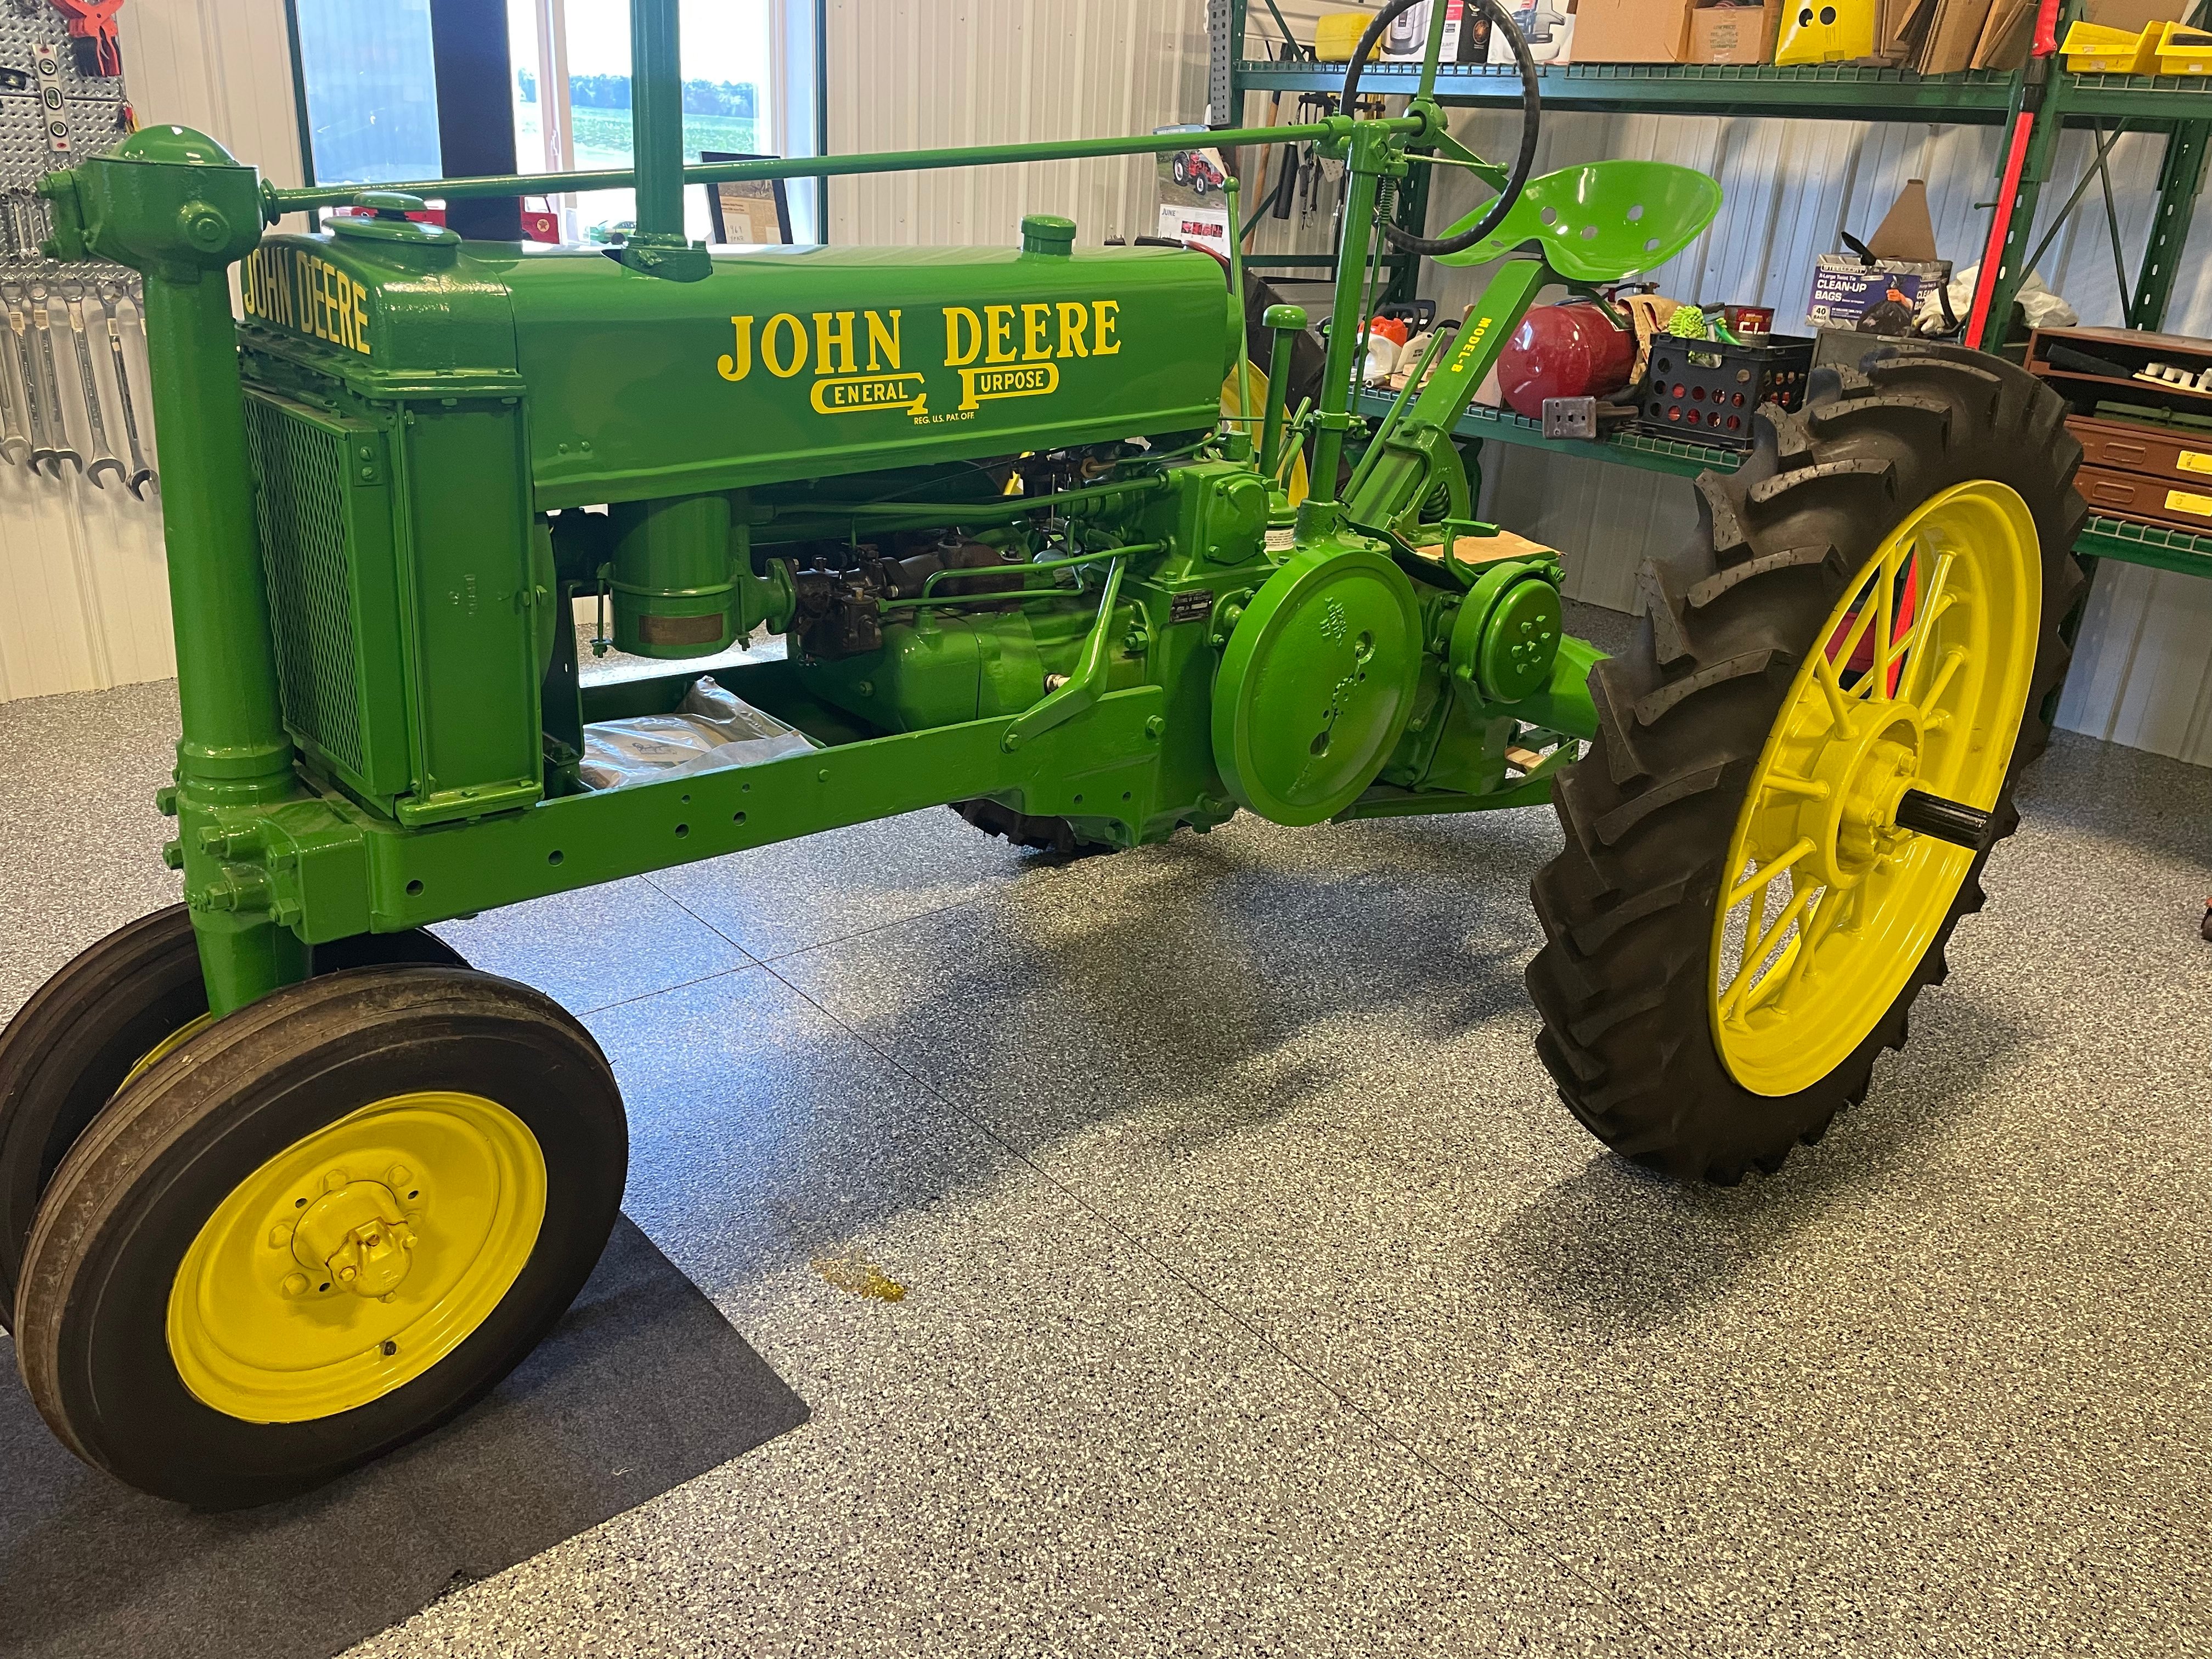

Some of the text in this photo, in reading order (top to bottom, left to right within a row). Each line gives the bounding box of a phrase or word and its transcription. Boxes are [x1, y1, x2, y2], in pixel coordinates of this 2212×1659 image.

[1162, 208, 1176, 216] JUNE
[726, 225, 742, 234] 1969
[1817, 279, 1867, 293] CLEAN-UP
[244, 247, 370, 354] JOHN DEERE
[1815, 290, 1842, 302] BAGS
[717, 300, 1122, 381] JOHN DEERE
[1451, 317, 1492, 373] MODEL-B
[914, 416, 930, 425] REG.
[946, 413, 960, 421] PAT.
[961, 411, 975, 420] OFF.
